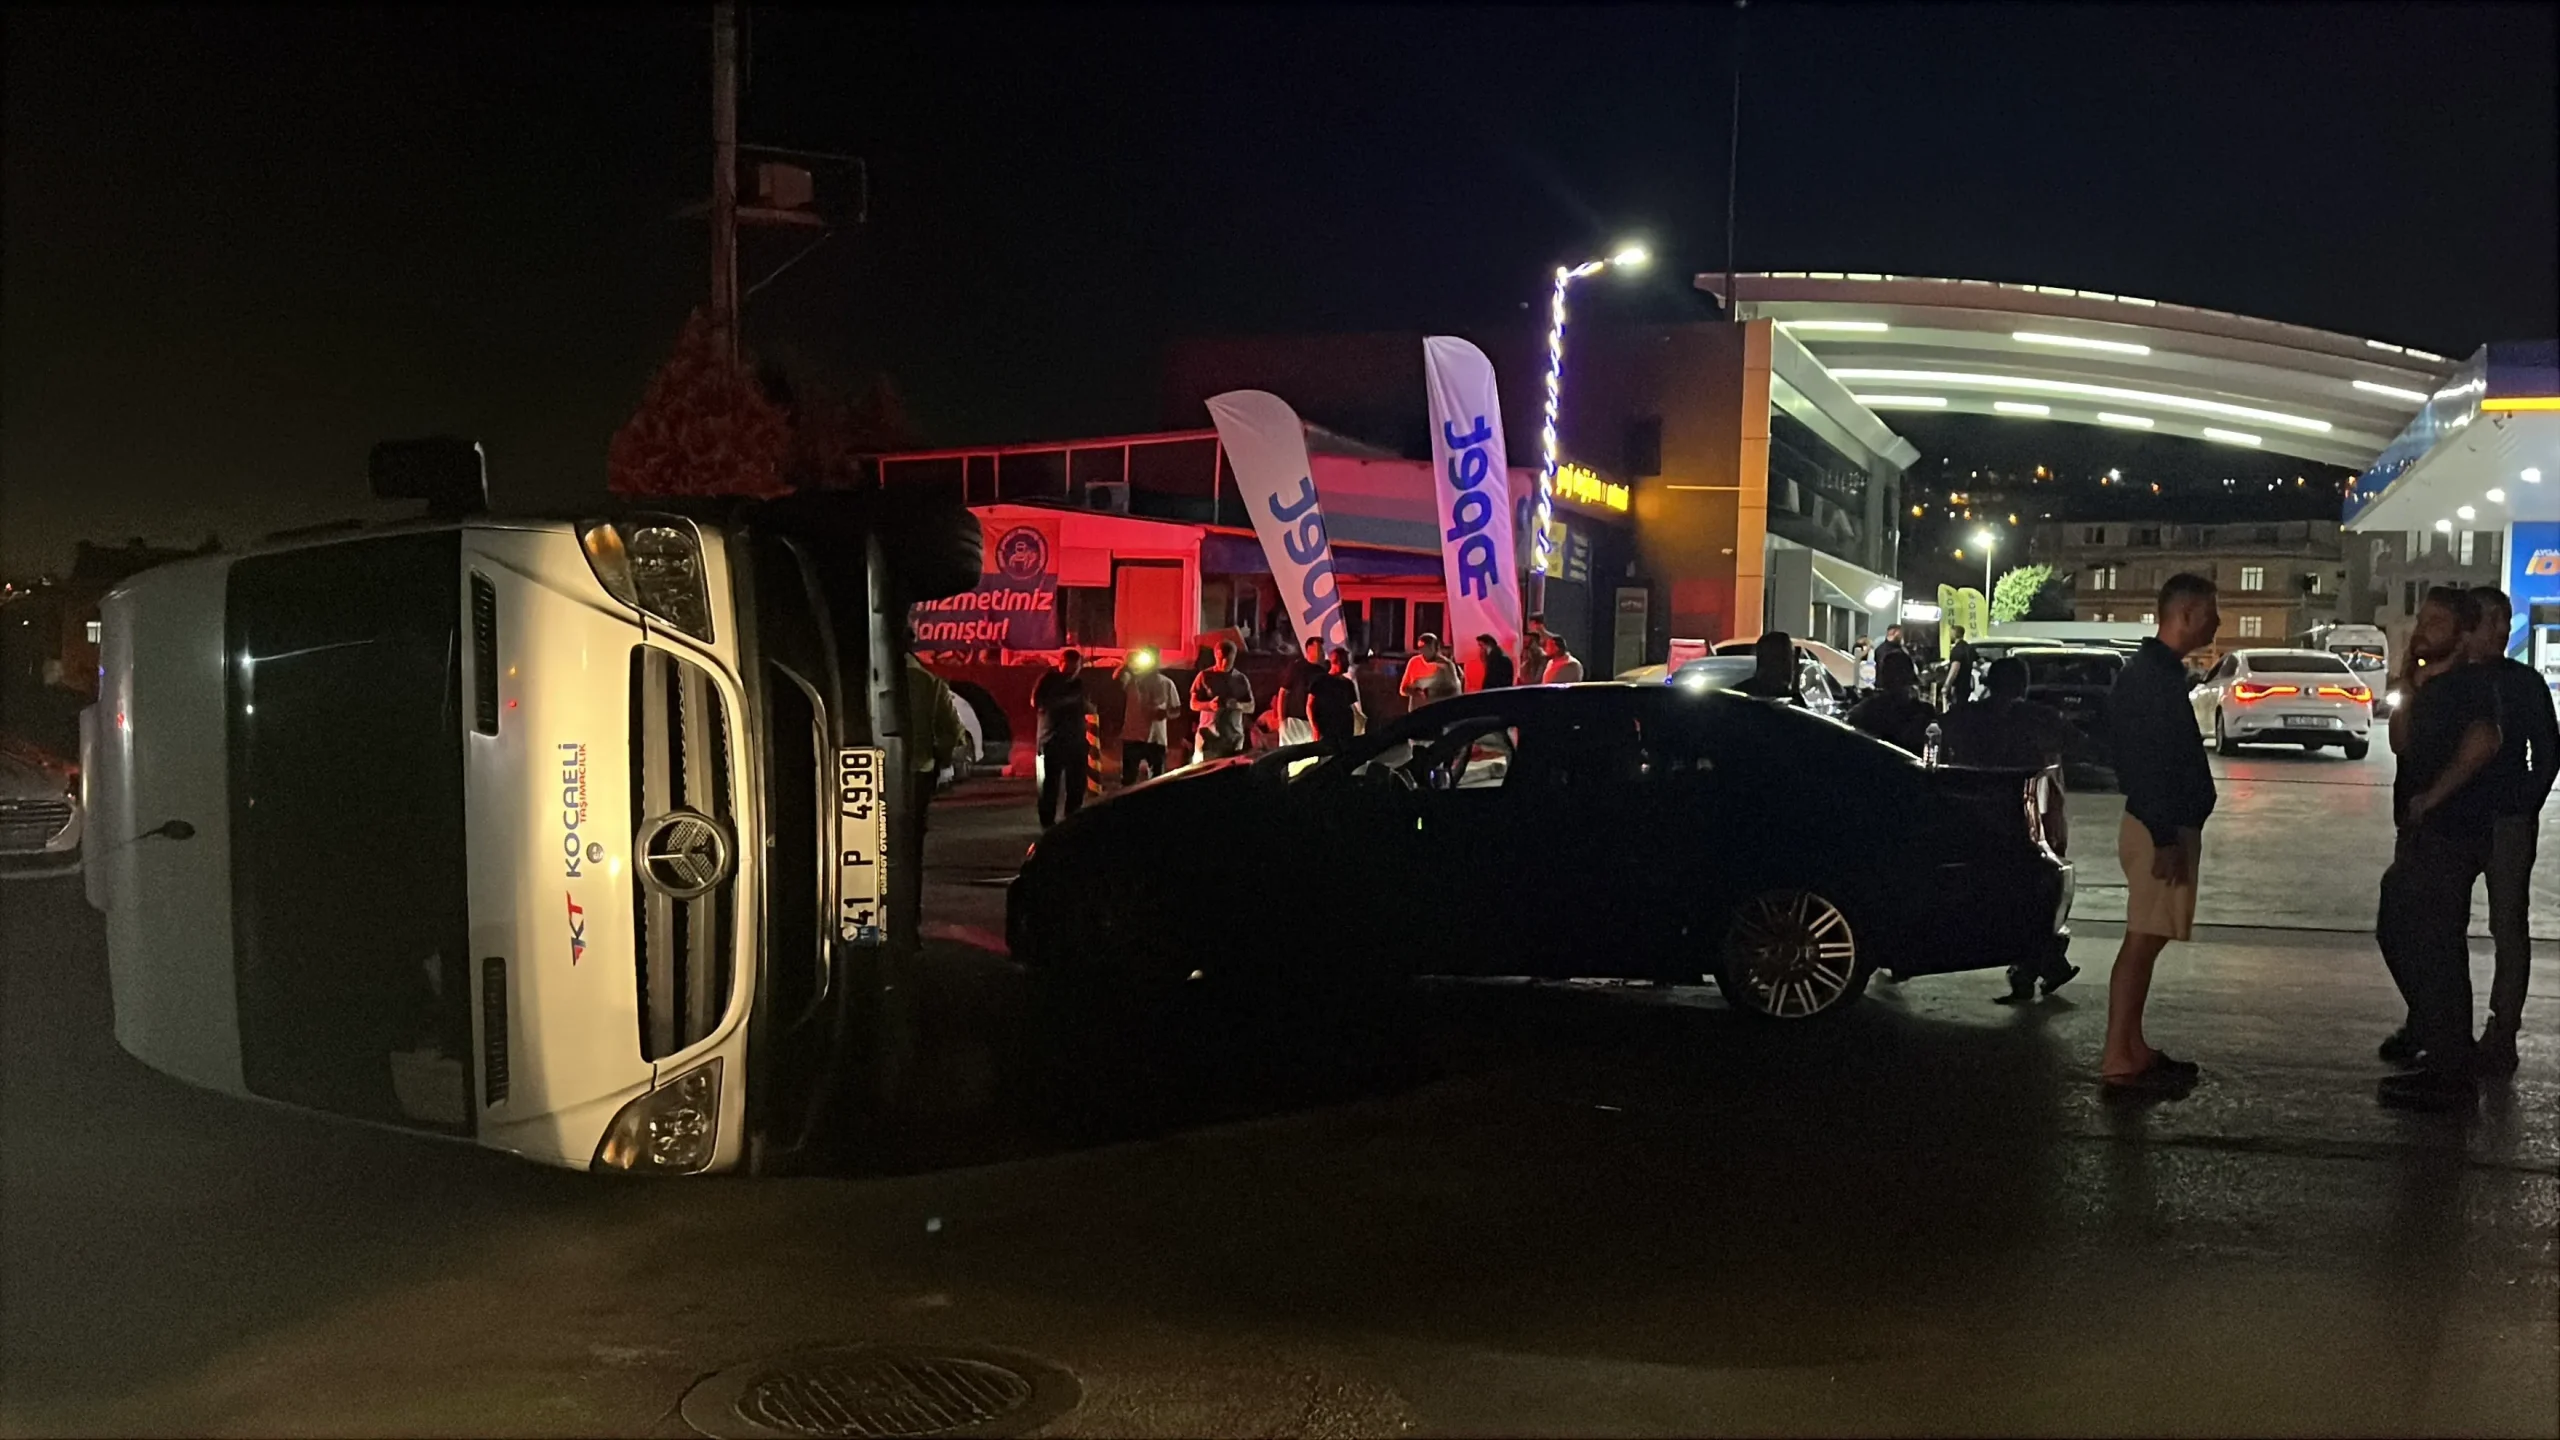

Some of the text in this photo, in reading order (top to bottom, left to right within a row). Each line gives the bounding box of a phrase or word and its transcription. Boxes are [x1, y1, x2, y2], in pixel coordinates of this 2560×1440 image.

[558, 743, 581, 878] KOCAELİ
[579, 744, 588, 823] TAŞIMACILIK
[841, 753, 873, 820] 4938
[843, 850, 873, 866] P
[843, 896, 874, 925] 41
